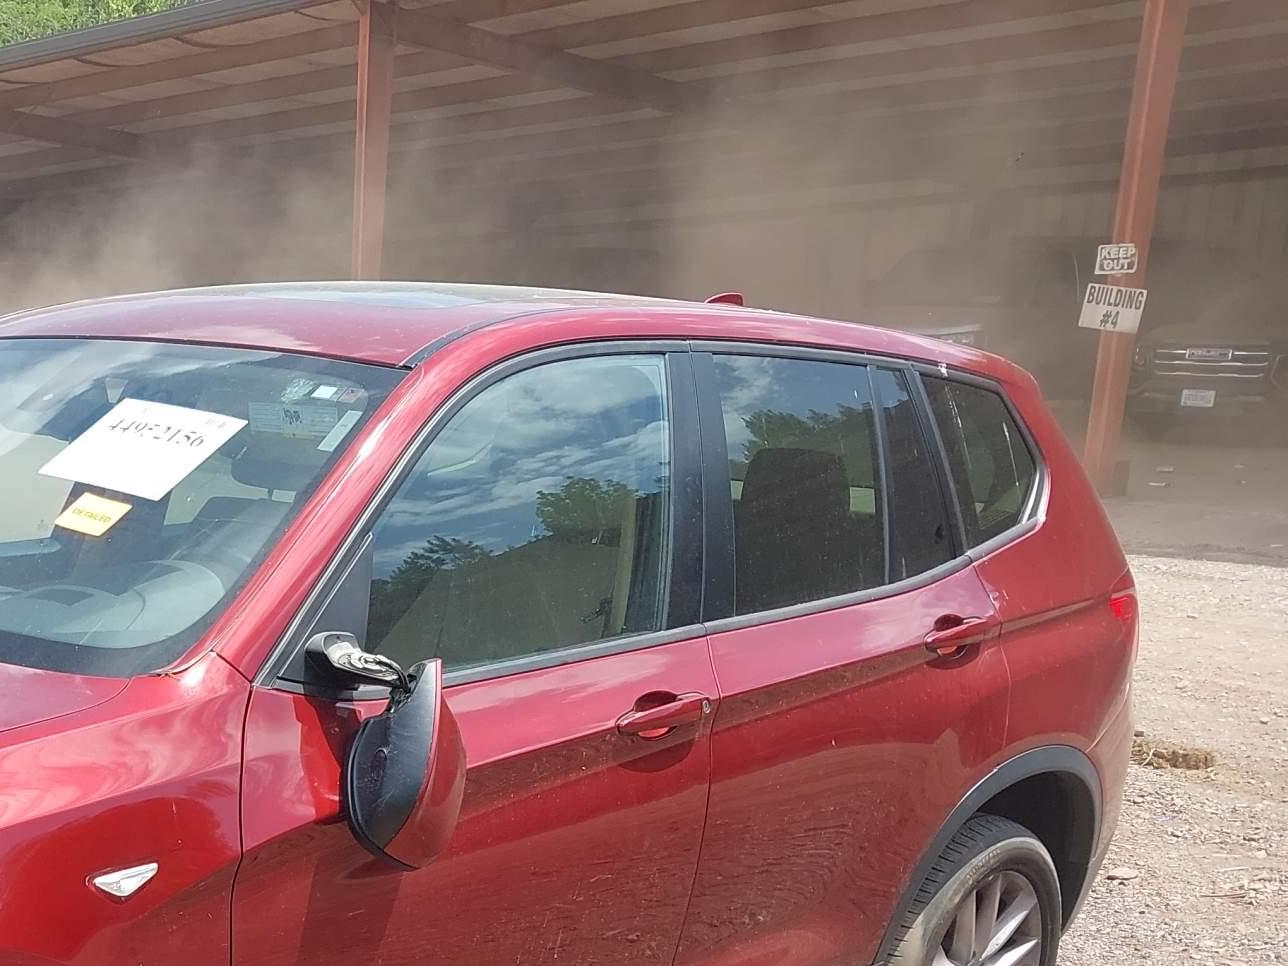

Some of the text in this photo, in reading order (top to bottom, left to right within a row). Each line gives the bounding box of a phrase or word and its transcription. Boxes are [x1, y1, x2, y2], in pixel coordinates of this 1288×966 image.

[1101, 246, 1136, 259] KEEP
[1102, 259, 1132, 271] OUT
[1086, 285, 1144, 310] BUILDING
[1099, 310, 1120, 329] #4
